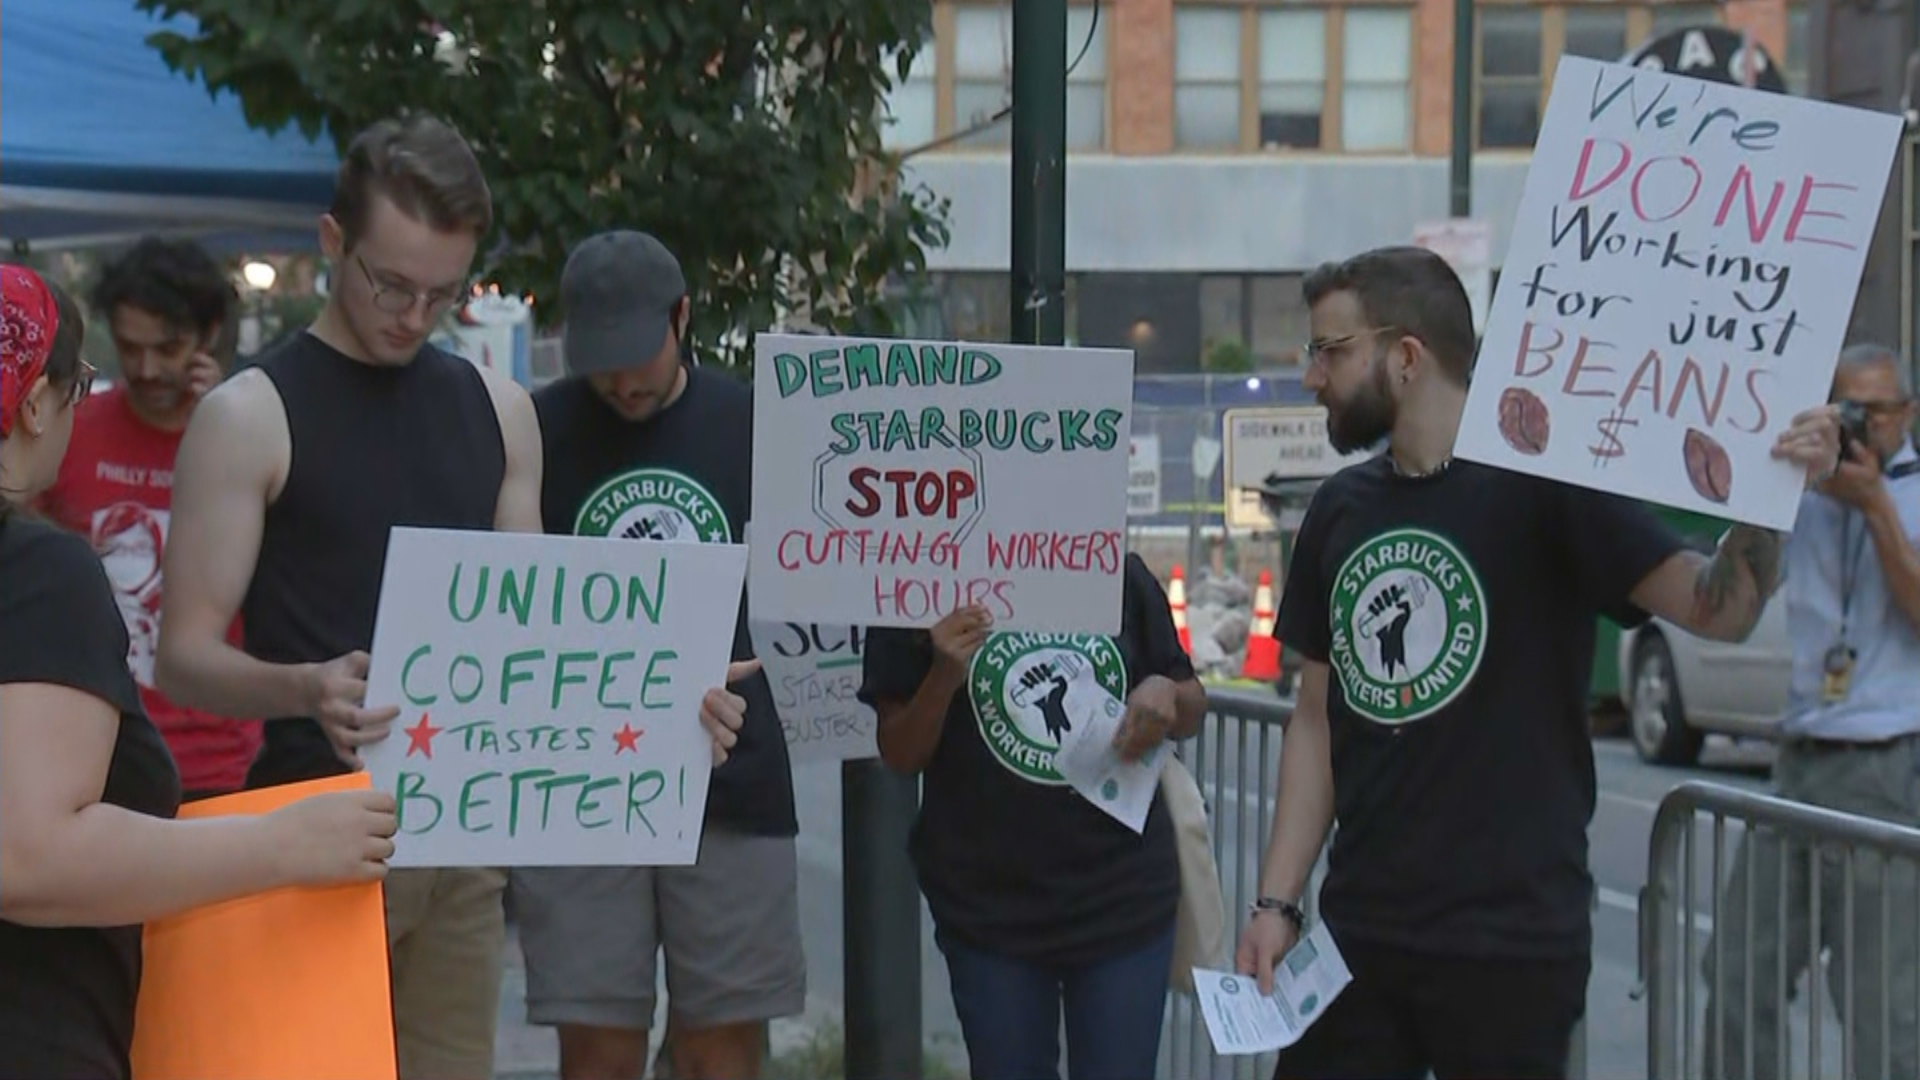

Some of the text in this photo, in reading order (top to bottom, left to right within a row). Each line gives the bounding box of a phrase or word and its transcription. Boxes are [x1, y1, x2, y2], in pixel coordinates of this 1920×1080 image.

[1589, 68, 1780, 151] We're
[1568, 138, 1859, 251] DONE
[1551, 204, 1791, 312] Working
[1521, 263, 1812, 356] for just
[773, 344, 1002, 398] DEMAND
[1513, 321, 1770, 434] BEANS
[828, 406, 1124, 454] STARBUCKS
[589, 479, 713, 528] STARBUCKS
[845, 467, 977, 519] STOP
[777, 529, 1124, 575] CUTTING WORKERS
[1342, 541, 1463, 596] STARBUCKS
[448, 558, 667, 626] UNION
[873, 574, 1016, 621] HOURS
[402, 645, 679, 709] COFFEE
[1333, 622, 1475, 709] WORKERS UNITED
[447, 720, 599, 753] TASTES
[980, 699, 1054, 771] WORKER
[397, 766, 685, 839] BETTER!
